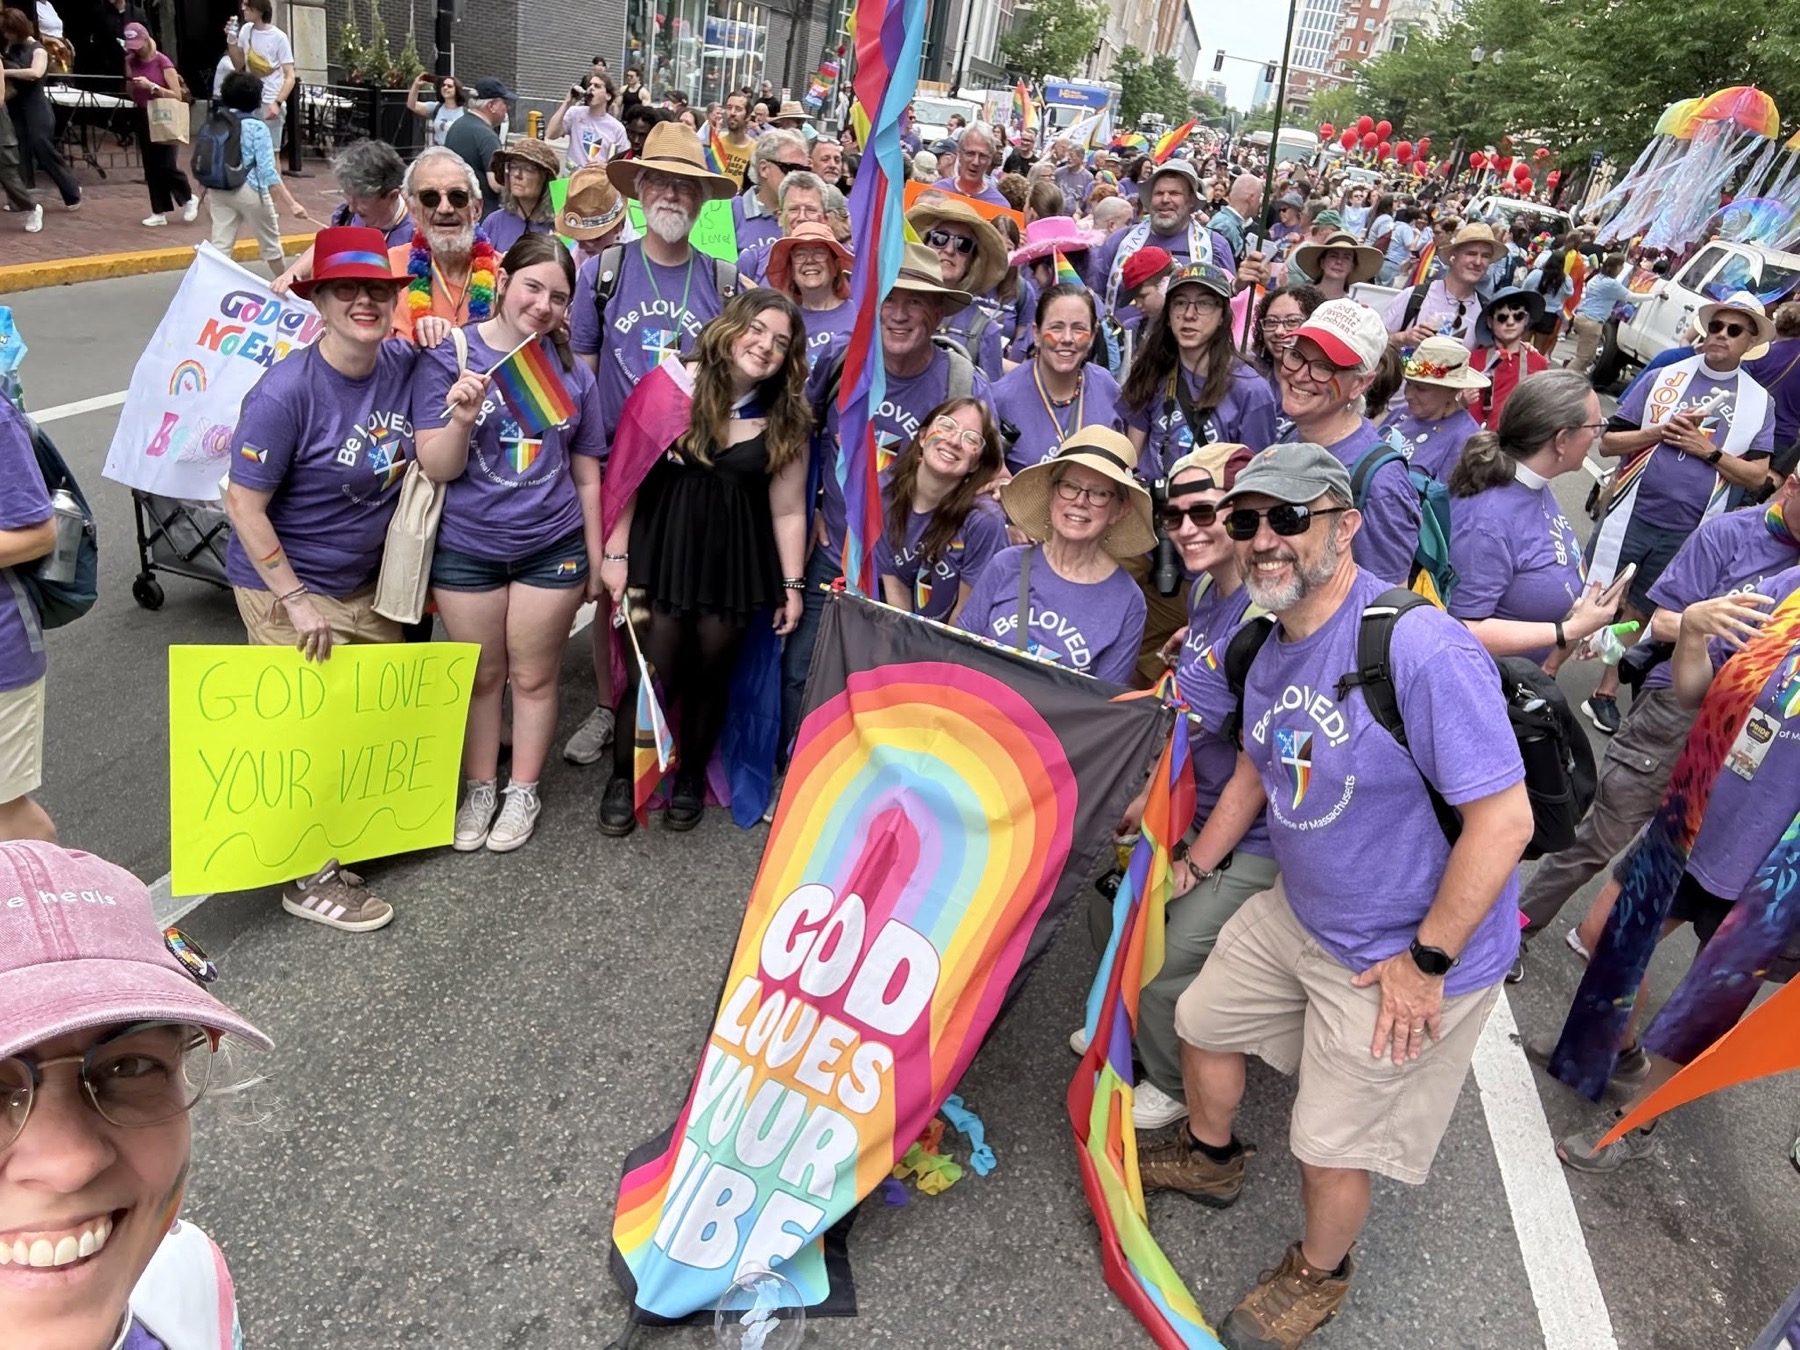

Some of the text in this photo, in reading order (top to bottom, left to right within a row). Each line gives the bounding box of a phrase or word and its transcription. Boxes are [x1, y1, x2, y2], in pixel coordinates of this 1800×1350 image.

[220, 290, 281, 326] GOD
[614, 309, 640, 335] Be
[196, 318, 245, 356] NO
[1649, 371, 1688, 424] JOY
[336, 436, 362, 468] Be
[488, 471, 518, 488] Diocese
[1555, 540, 1569, 566] Be
[992, 607, 1092, 673] Be LOVED!
[198, 656, 465, 721] GOD LOVES
[1251, 684, 1350, 748] Be LOVED!
[1749, 721, 1771, 739] PRIDE
[1779, 730, 1790, 739] of
[198, 734, 437, 821] YOUR VIBE
[1298, 821, 1309, 832] of
[1308, 774, 1356, 831] Massachusetts
[39, 889, 118, 908] heals
[760, 882, 942, 1037] GOD
[715, 975, 895, 1115] LOVES
